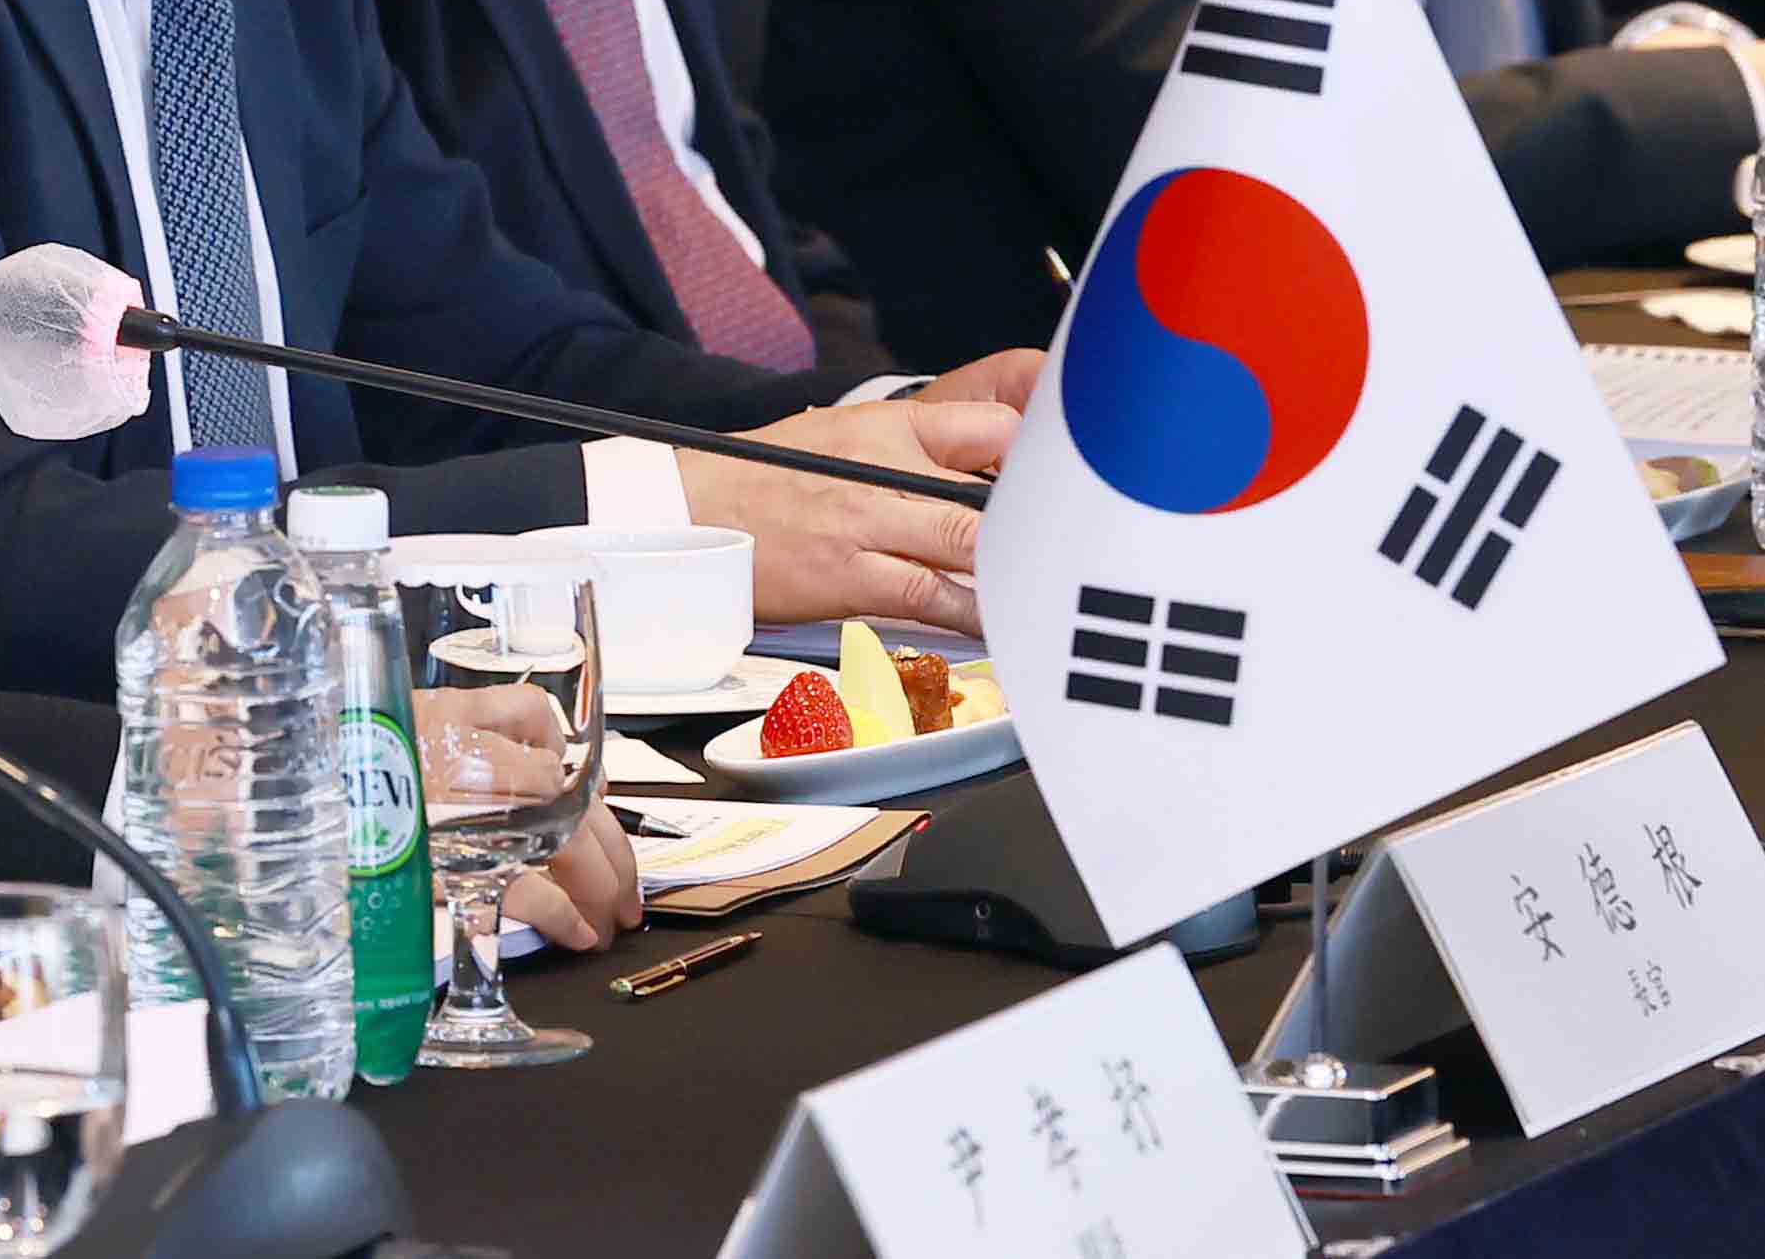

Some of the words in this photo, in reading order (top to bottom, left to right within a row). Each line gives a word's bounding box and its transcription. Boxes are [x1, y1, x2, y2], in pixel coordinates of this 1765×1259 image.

[340, 769, 413, 810] REVI
[1510, 823, 1703, 962] 安德根
